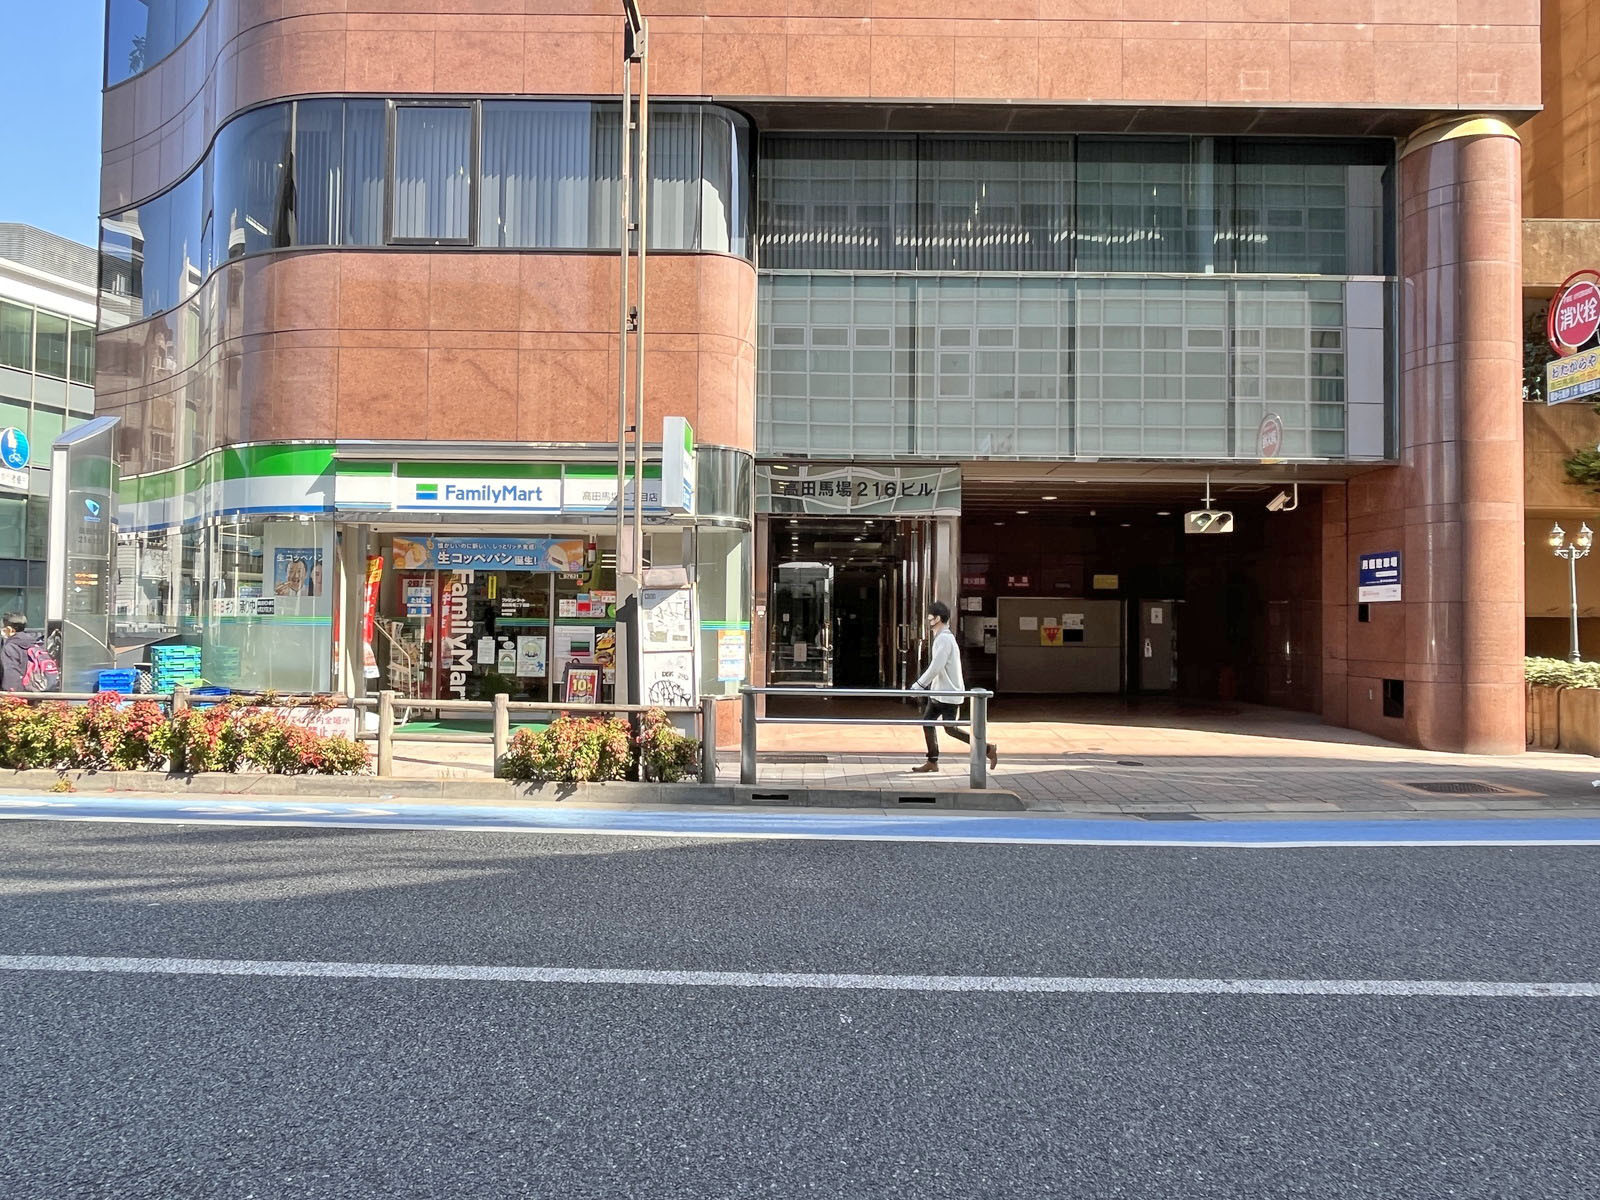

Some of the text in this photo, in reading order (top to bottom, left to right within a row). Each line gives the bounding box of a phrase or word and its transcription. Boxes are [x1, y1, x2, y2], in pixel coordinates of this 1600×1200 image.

[1560, 298, 1598, 331] 消火栓
[445, 484, 543, 503] FamilyMart
[783, 480, 933, 497] 高田馬場216ビル
